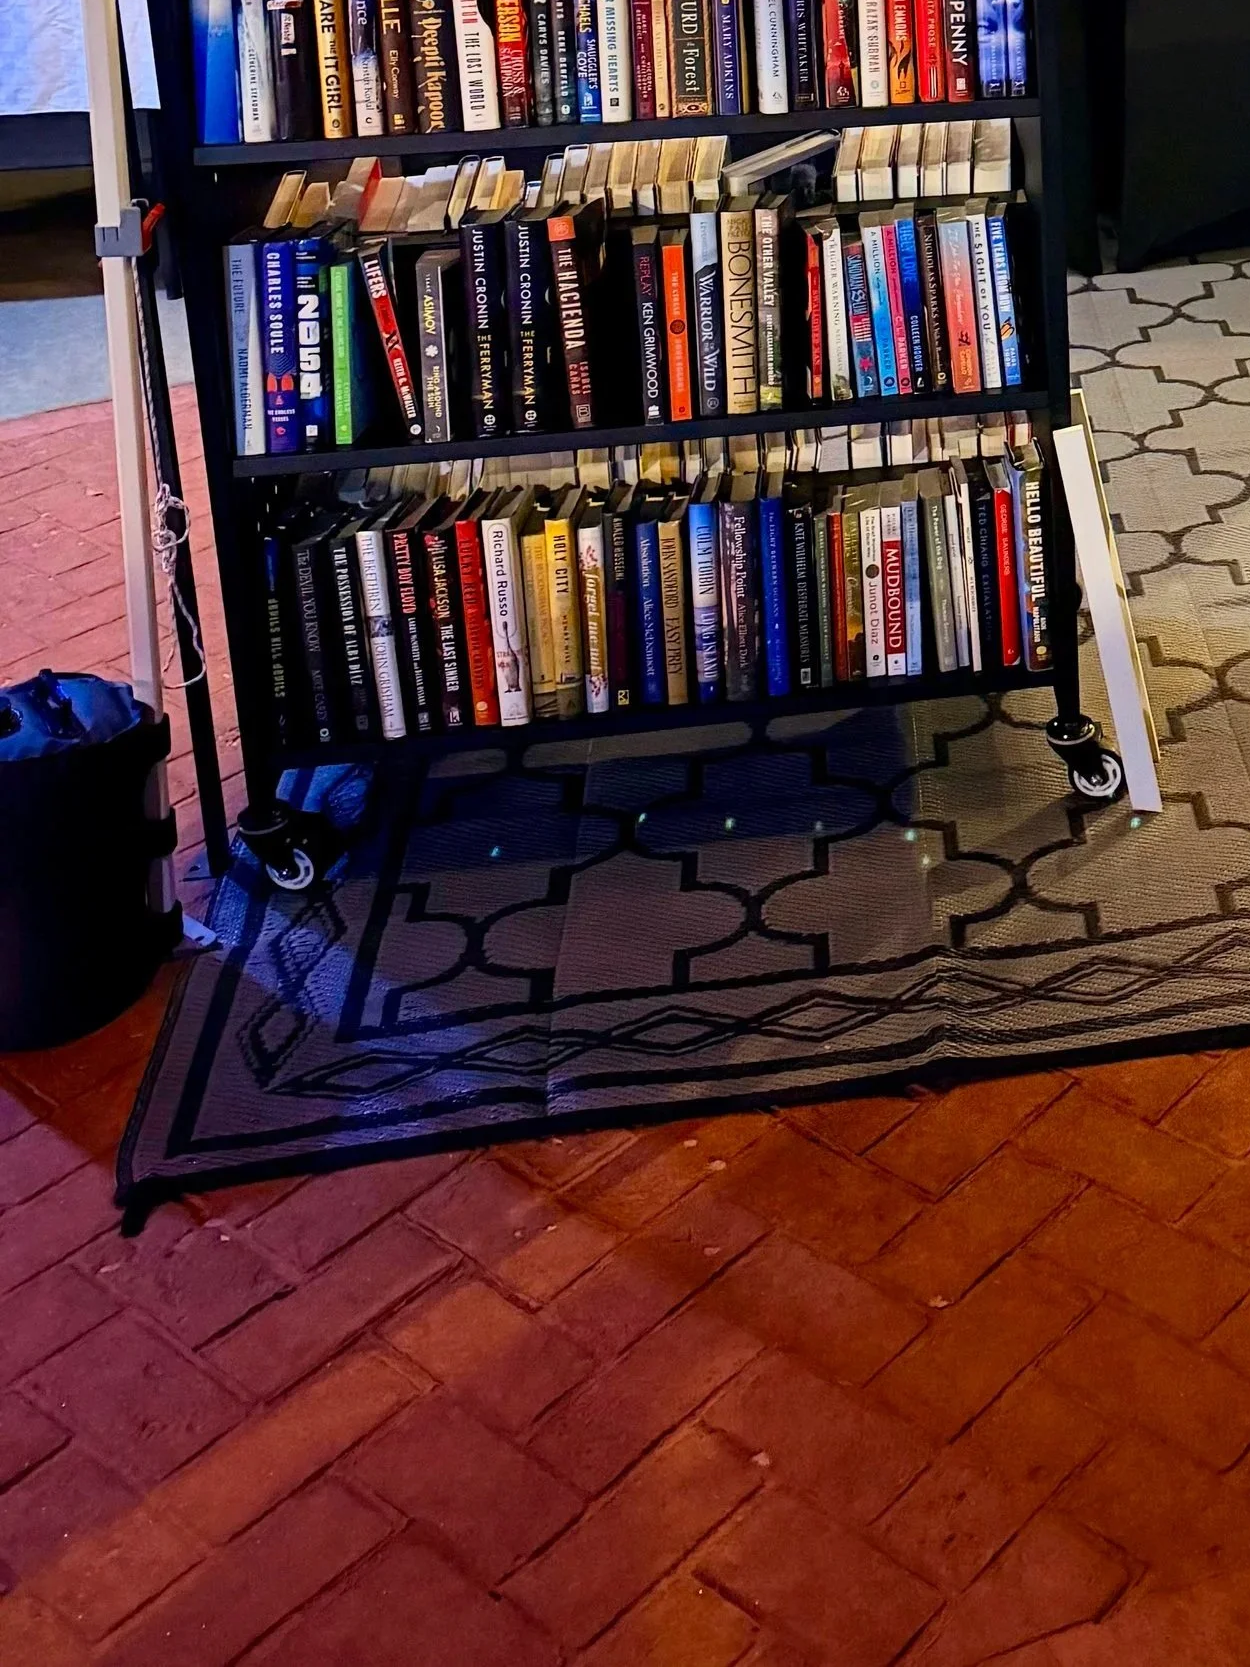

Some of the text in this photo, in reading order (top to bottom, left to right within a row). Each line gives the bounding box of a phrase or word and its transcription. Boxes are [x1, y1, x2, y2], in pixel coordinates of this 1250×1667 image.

[465, 32, 480, 48] THE
[537, 14, 547, 45] CARYS
[605, 7, 616, 50] MISSING
[722, 14, 732, 50] MARY
[769, 11, 779, 77] CUNNINGHAM
[797, 23, 809, 83] WHITAKER
[949, 0, 968, 66] PENNY
[324, 56, 339, 72] IT
[467, 54, 482, 74] LOST
[539, 49, 549, 84] DAVIES
[577, 51, 587, 78] COVE
[587, 39, 598, 89] SMUGGLER'S
[607, 55, 618, 92] HEARTS
[682, 49, 700, 92] Forest
[723, 52, 734, 99] ADKINS
[326, 75, 342, 113] GIRL
[468, 80, 485, 110] WORLD
[472, 229, 489, 329] JUSTIN CRONIN
[517, 225, 533, 325] JUSTIN CRONIN
[828, 238, 841, 326] TRIGGER WARNING
[974, 243, 986, 283] SIGHT
[990, 222, 1012, 313] FIVE YEARS FROM NOW
[266, 252, 284, 354] CHARLES SOULE
[557, 249, 586, 350] THE HACIENDA
[698, 270, 716, 341] WARRIOR
[727, 241, 756, 395] BONESMITH
[898, 224, 924, 372] UGLY LOVE COLLEEN HOOVER
[980, 289, 986, 300] OF
[981, 304, 990, 330] YOU
[232, 259, 252, 430] THE FUTURE NAOMI ALDERMAN
[639, 256, 659, 398] REPLAY KEN GRIMWOOD
[896, 337, 908, 370] PARKER
[432, 366, 442, 418] RING AROUND
[478, 343, 494, 409] FERRYMAN
[521, 339, 536, 405] FERRYMAN
[703, 349, 720, 391] WILD
[427, 393, 435, 408] SUN
[553, 535, 569, 594] HOLY CITY
[731, 516, 747, 569] Fellowship
[977, 506, 989, 567] TED CHIANG
[1002, 538, 1011, 575] SAUNDERS
[1025, 482, 1045, 602] HELLO BEAUTIFUL
[492, 531, 509, 616] Richard Russo
[697, 526, 719, 679] COLM LONG ISLAND
[736, 571, 747, 598] Point
[794, 522, 809, 663] KATE WILHELM DESPERATE MEASURES
[868, 581, 878, 615] Junot
[886, 548, 902, 648] MUDBOUND
[360, 537, 395, 719] THE BRETHREN JOHN GRISHAM
[432, 556, 459, 692] LISA JACKSON THE LAST SINNER
[639, 536, 656, 676] Absolution Alice McDermott
[661, 538, 682, 675] JOHN SANDFORD EASY PREY
[737, 603, 747, 623] Alice
[296, 551, 327, 721] The DEVIL YOU KNOW MIKE CAREY
[740, 649, 750, 668] Dark
